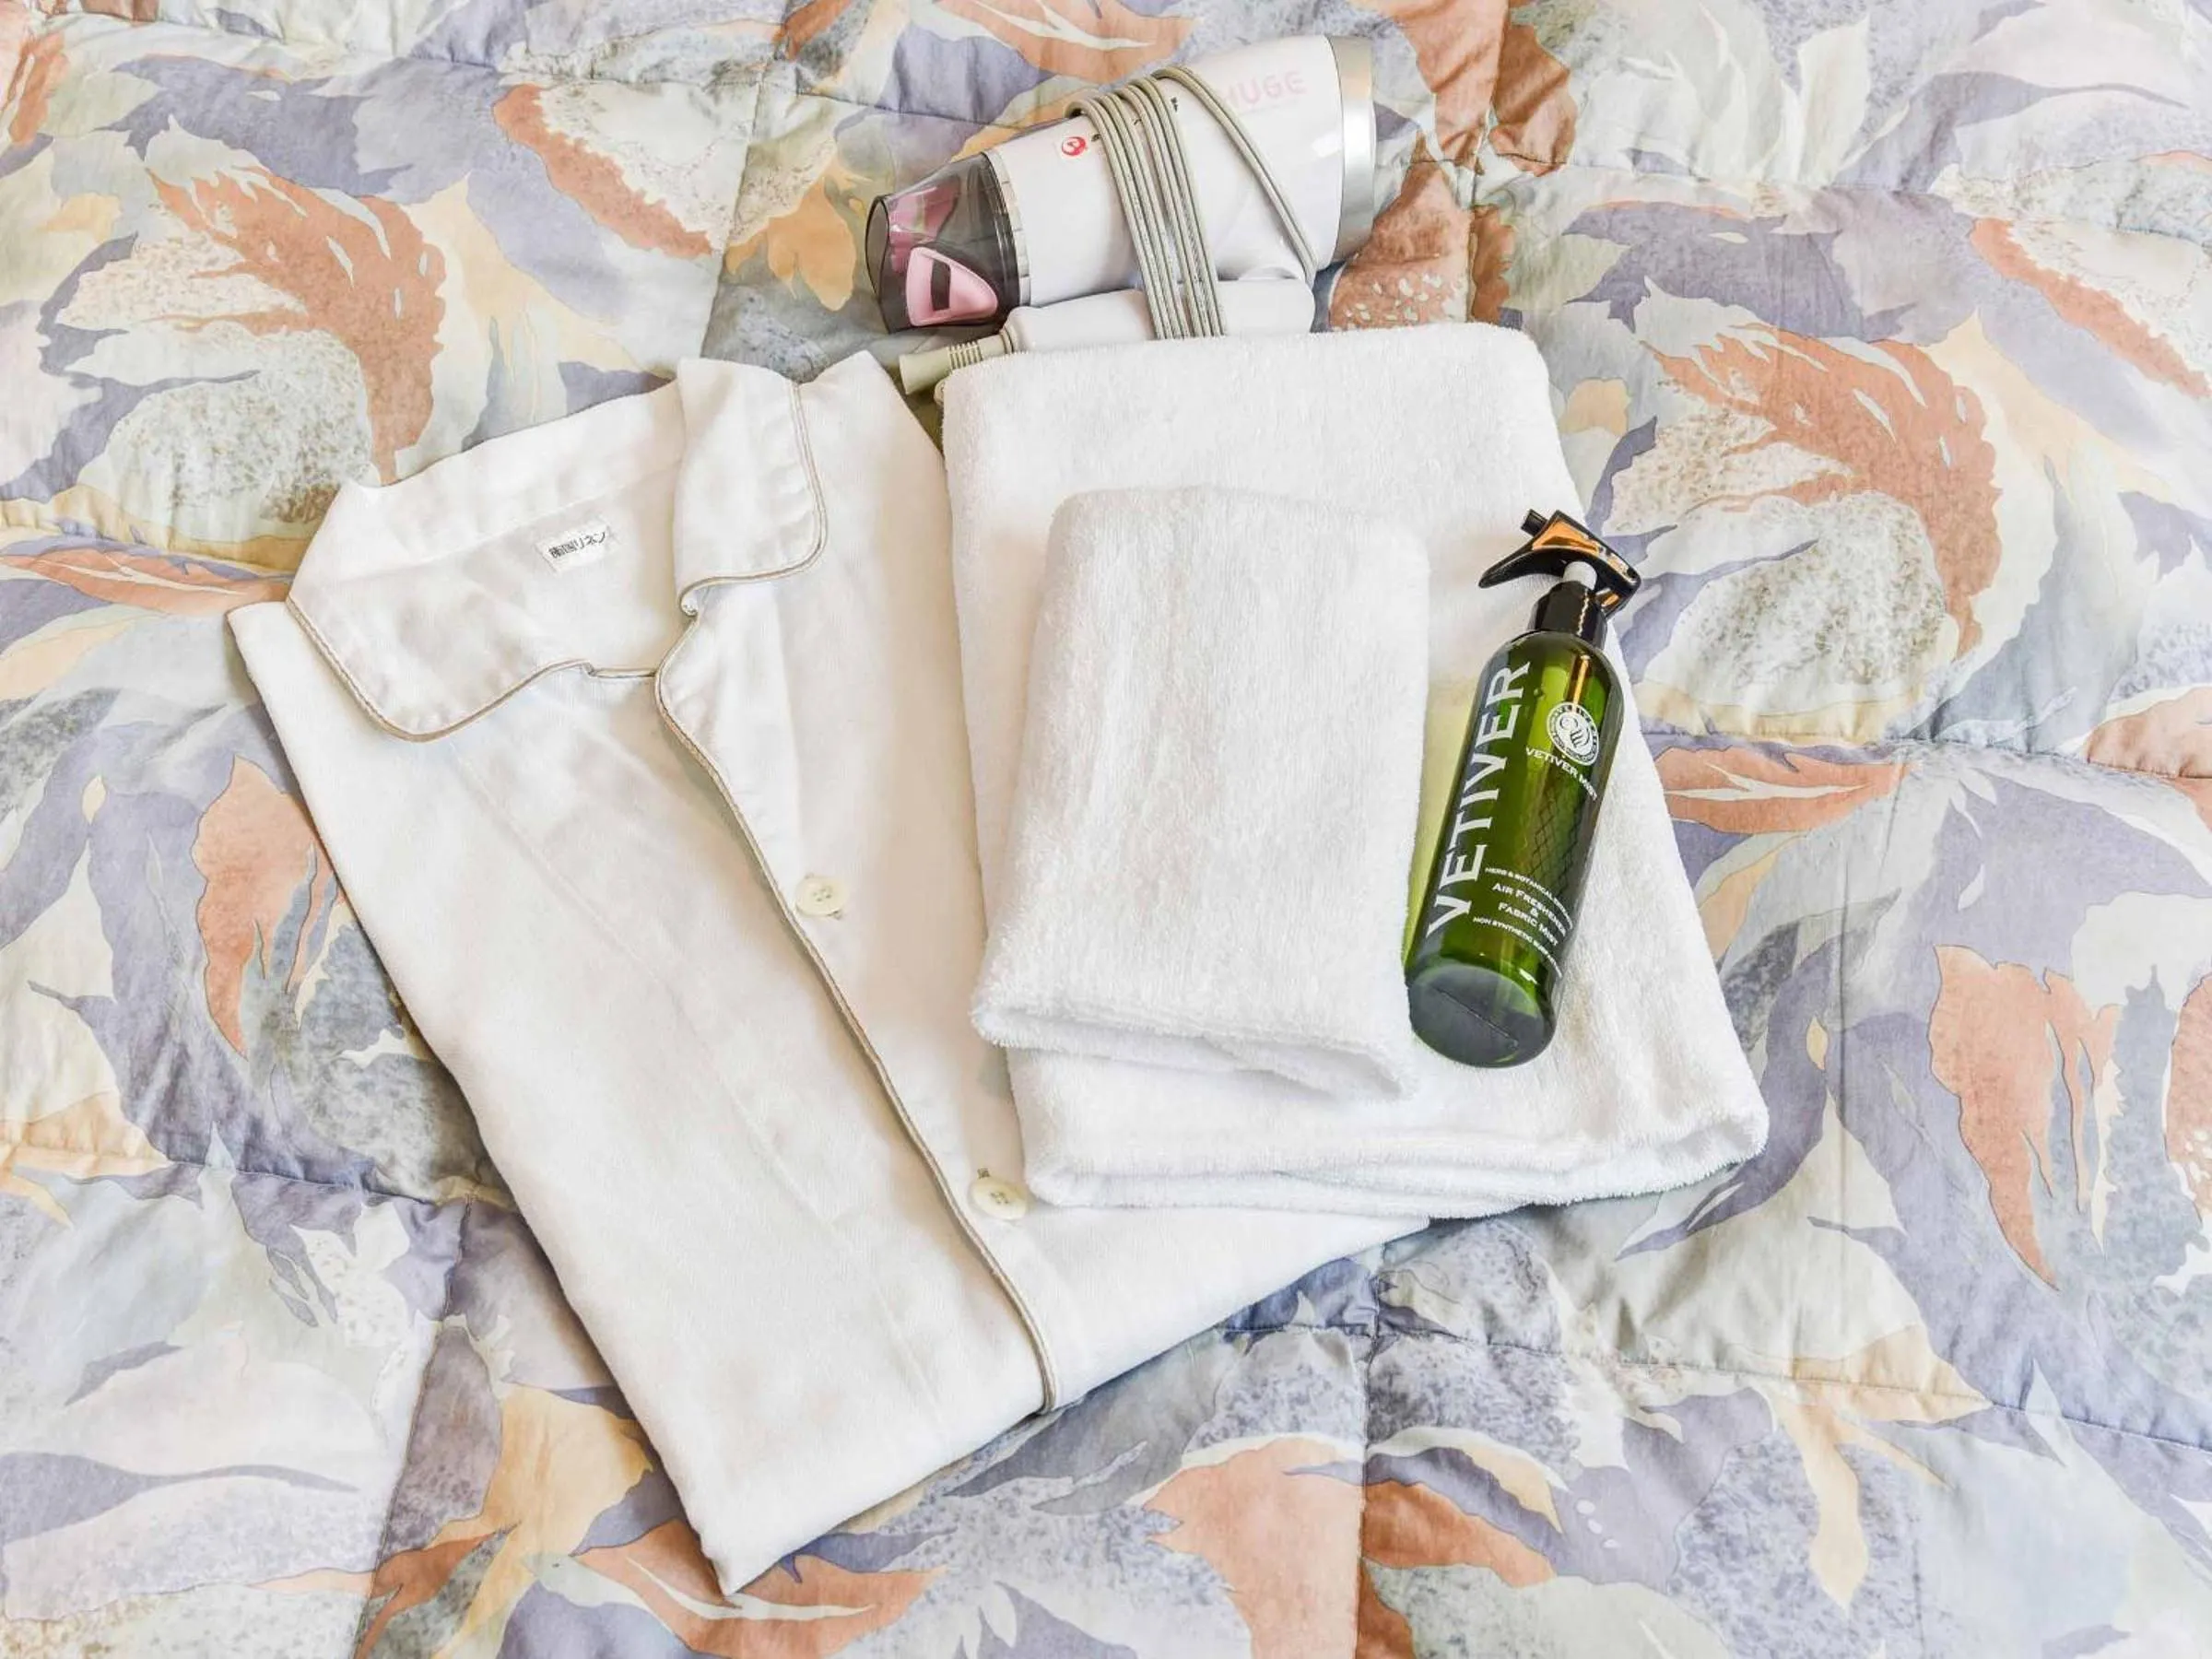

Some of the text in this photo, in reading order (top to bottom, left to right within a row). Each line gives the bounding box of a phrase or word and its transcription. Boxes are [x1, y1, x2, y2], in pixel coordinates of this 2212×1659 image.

[1526, 746, 1578, 778] VETIVER
[1426, 660, 1531, 939] VETIVER
[1492, 882, 1513, 895] AIR
[1515, 888, 1566, 937] FRESHENER
[1498, 901, 1537, 927] FABRIC
[1538, 923, 1559, 946] MIST
[1530, 907, 1539, 918] &
